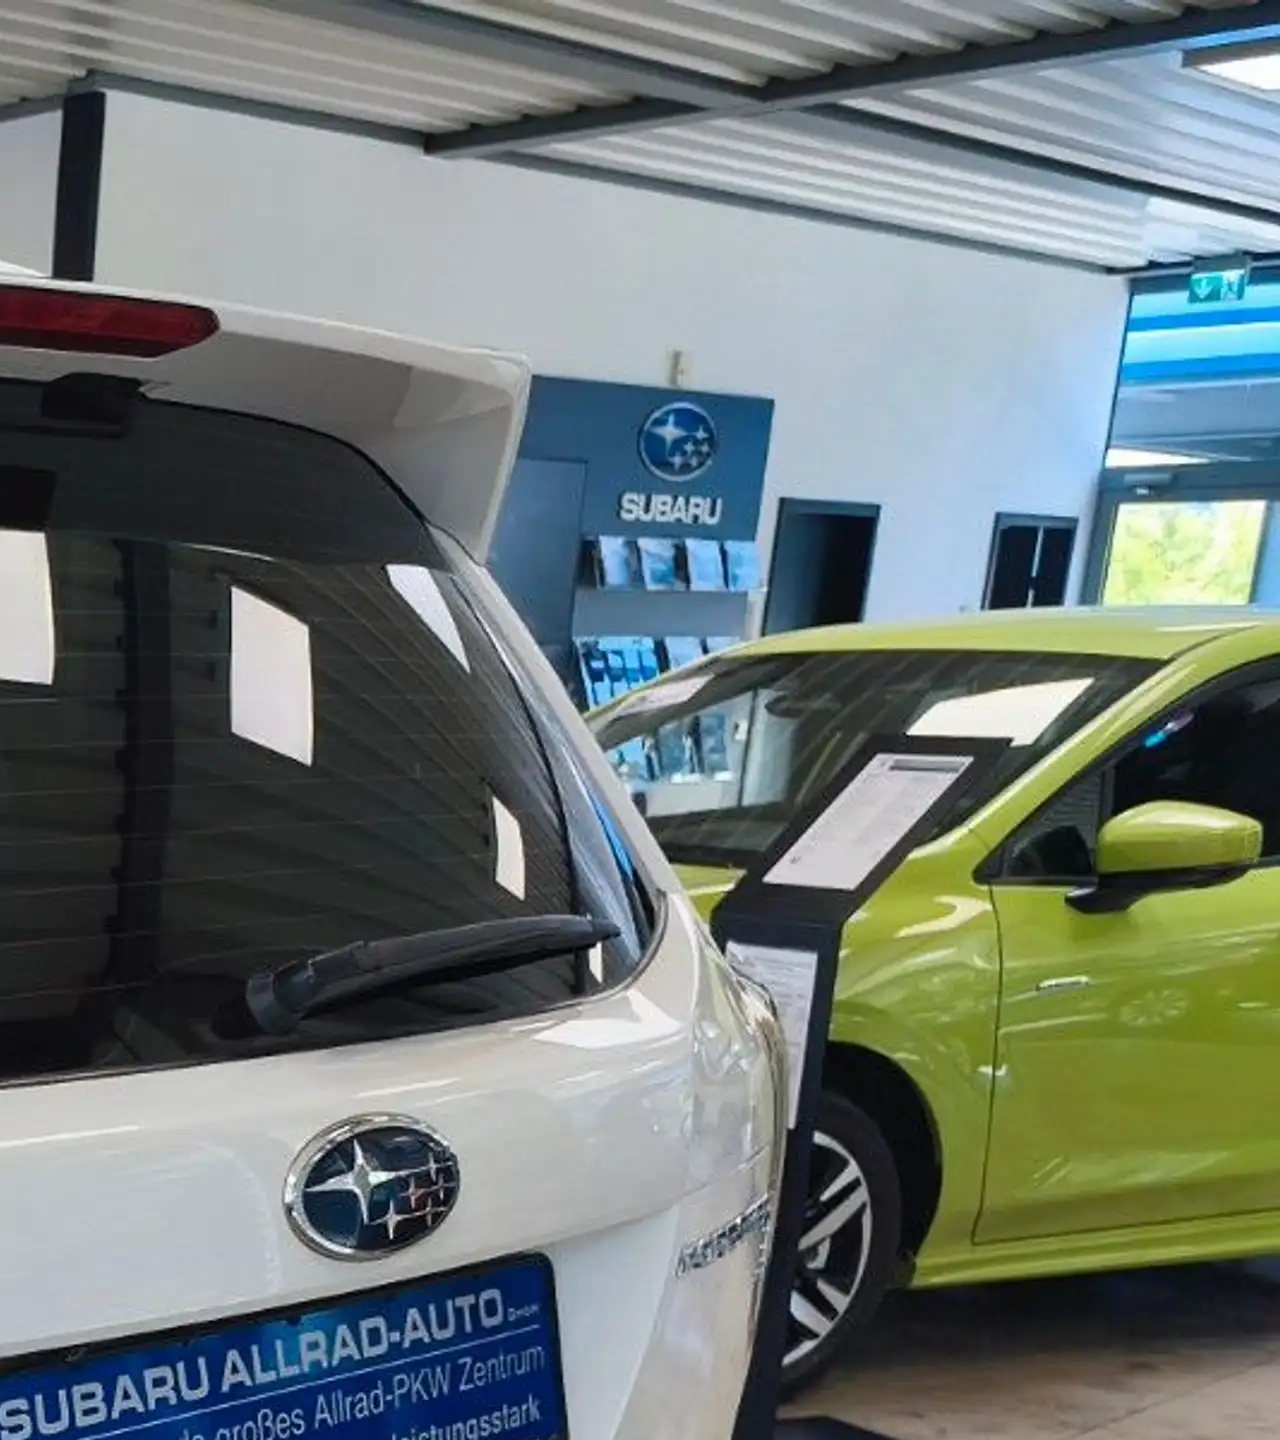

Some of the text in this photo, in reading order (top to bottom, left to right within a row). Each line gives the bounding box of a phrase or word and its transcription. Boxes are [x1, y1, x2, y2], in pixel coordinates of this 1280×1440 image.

[619, 492, 723, 525] SUBARU
[220, 1288, 504, 1393] ALLRAD-AUTO
[313, 1356, 451, 1430] Allrad-PKW
[457, 1346, 546, 1392] Zentrum
